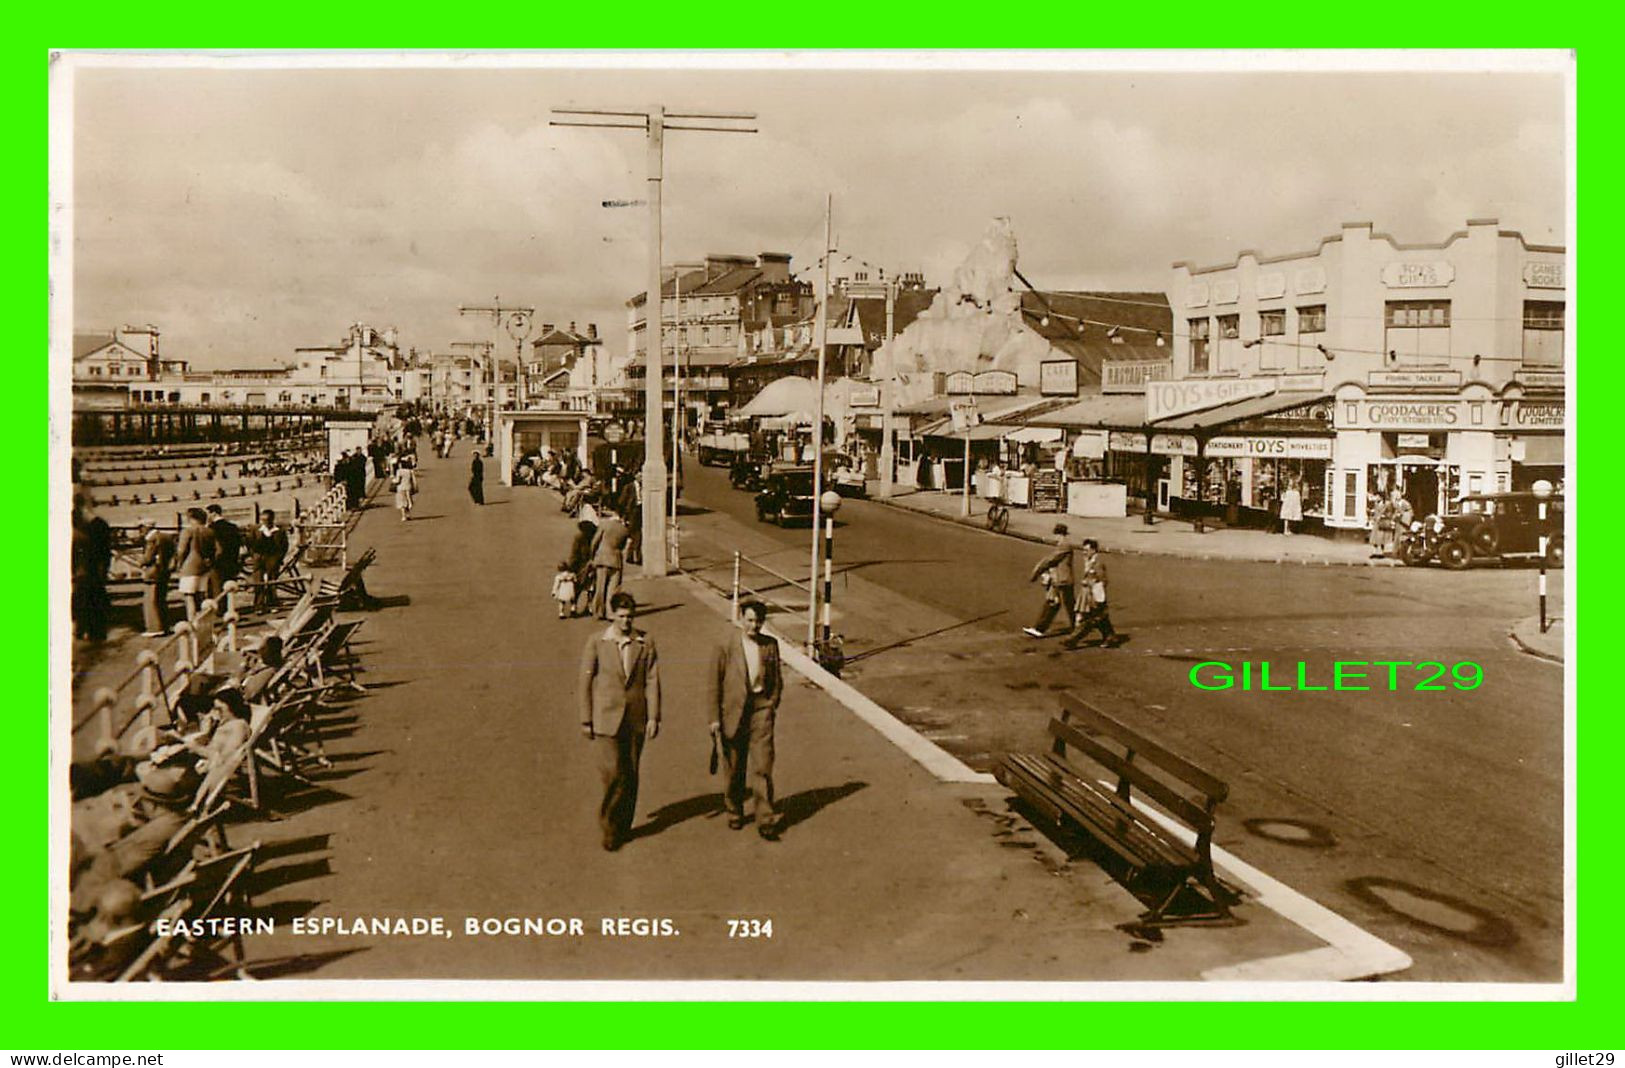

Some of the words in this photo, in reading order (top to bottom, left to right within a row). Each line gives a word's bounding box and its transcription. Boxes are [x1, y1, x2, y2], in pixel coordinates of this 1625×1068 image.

[1402, 263, 1435, 273] TOYS
[1532, 264, 1562, 274] GAMES
[1399, 274, 1437, 284] GIFTS
[1531, 275, 1562, 285] BOOKS
[1152, 384, 1200, 414] TOYS
[1368, 405, 1458, 424] GOODACRES
[1530, 417, 1564, 425] LIMITED
[1248, 440, 1285, 453] TOYS
